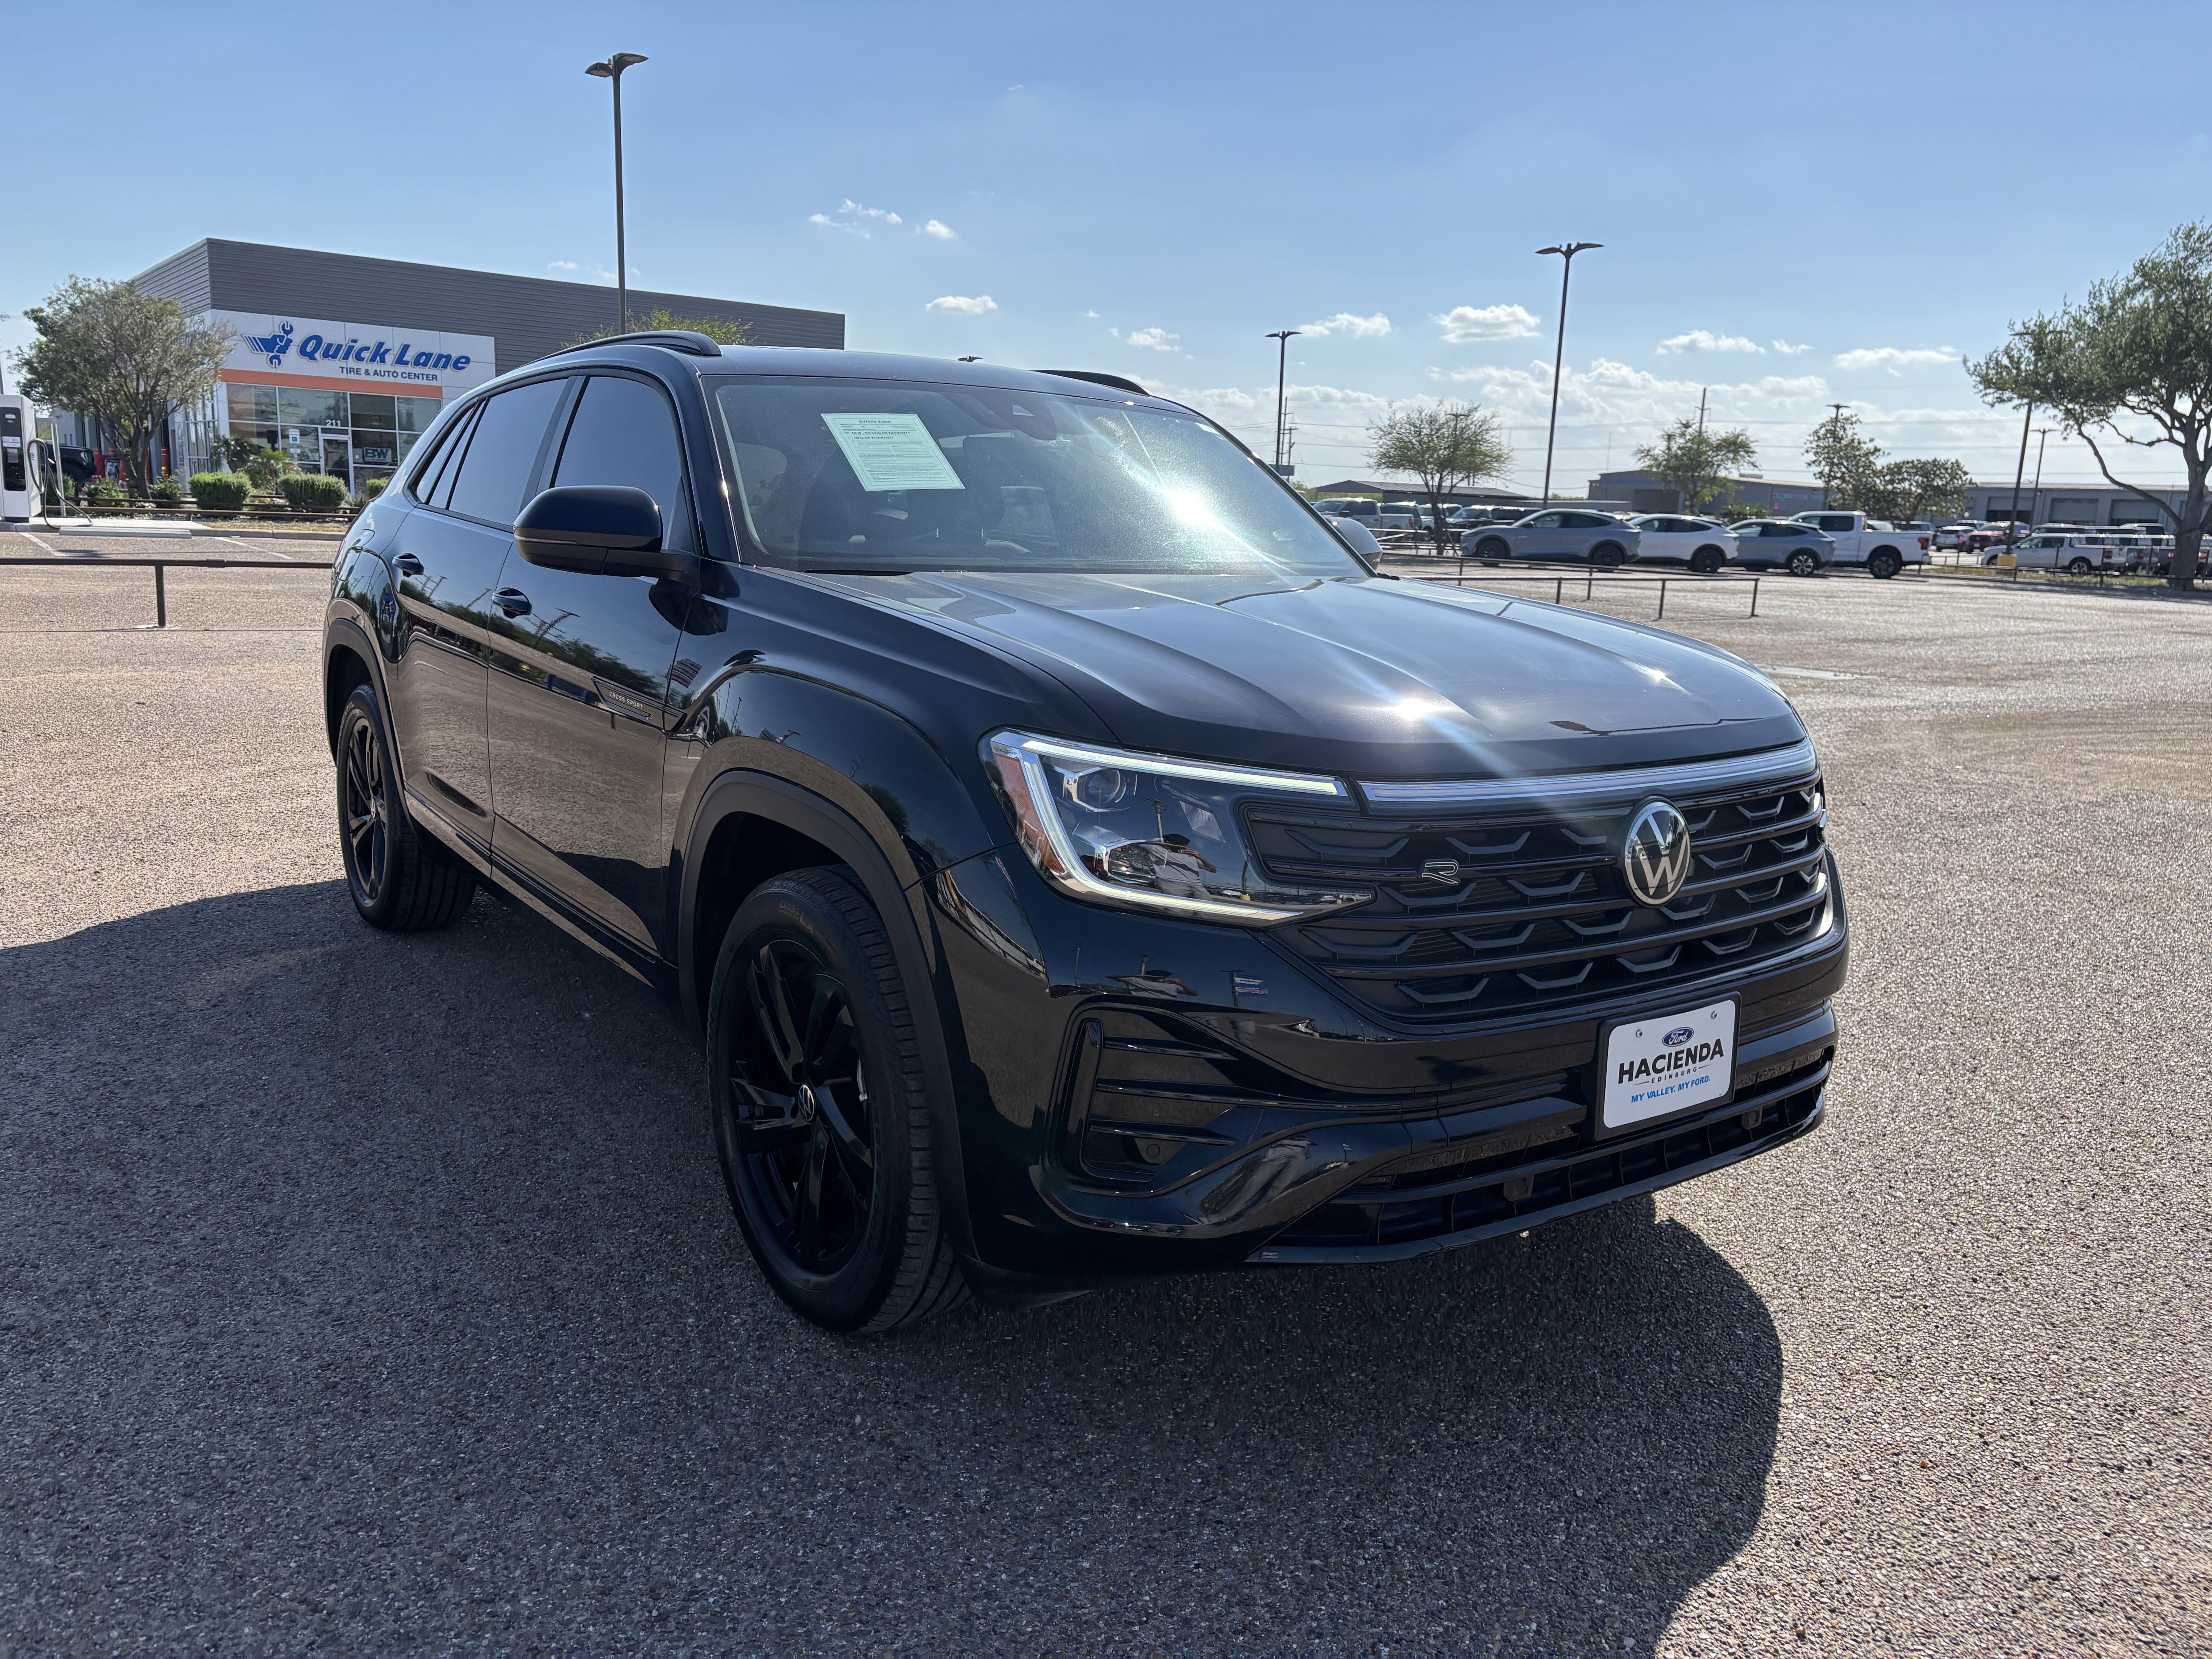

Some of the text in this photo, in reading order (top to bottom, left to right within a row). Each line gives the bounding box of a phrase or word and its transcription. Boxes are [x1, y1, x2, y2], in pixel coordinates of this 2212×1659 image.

[299, 334, 471, 371] Quick Lane
[339, 366, 361, 375] TIRE
[373, 370, 398, 378] AUTO
[401, 372, 438, 381] CENTER
[610, 692, 643, 709] CROSS SPORT
[1669, 1030, 1687, 1045] Ford
[1618, 1038, 1724, 1084] HACIENDA
[1652, 1067, 1697, 1084] EDINBURG
[1631, 1075, 1710, 1103] MY VALLEY. MY FORD.
